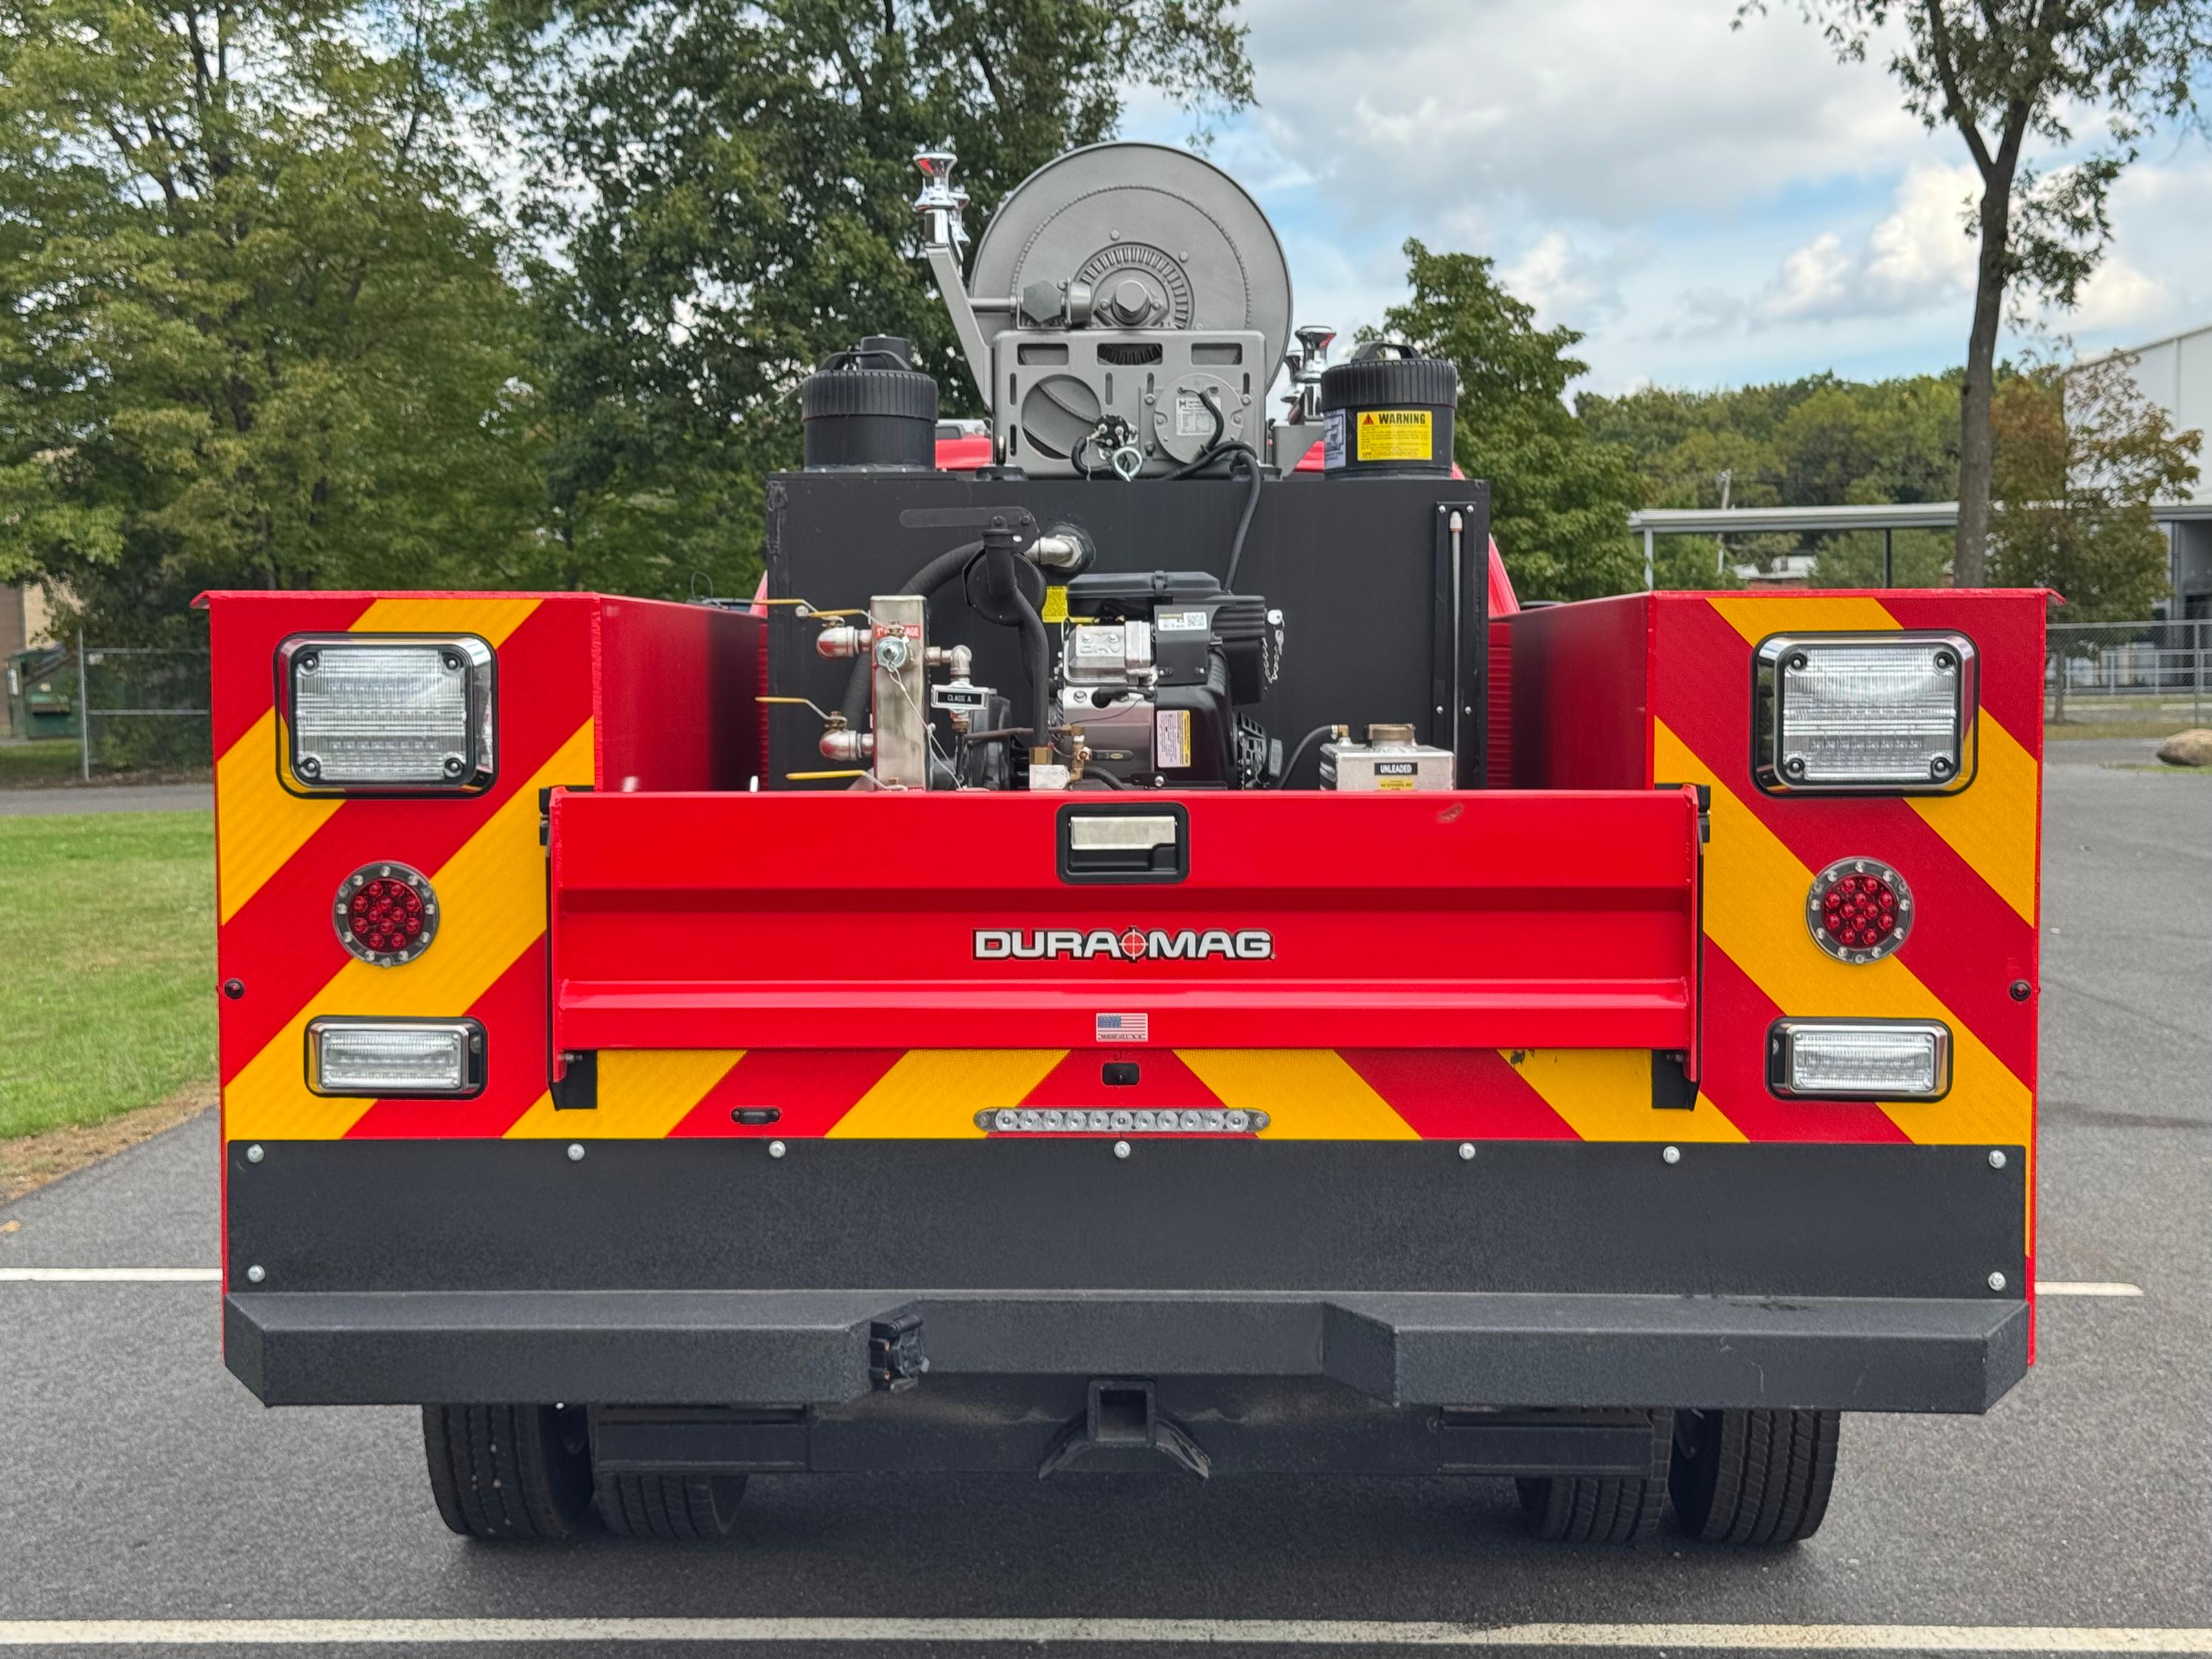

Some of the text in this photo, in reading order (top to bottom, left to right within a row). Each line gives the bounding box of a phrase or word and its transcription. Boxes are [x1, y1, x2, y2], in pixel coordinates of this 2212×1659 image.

[1378, 413, 1426, 425] WARNING
[947, 694, 965, 703] CLASS
[1380, 764, 1412, 773] UNLEADED
